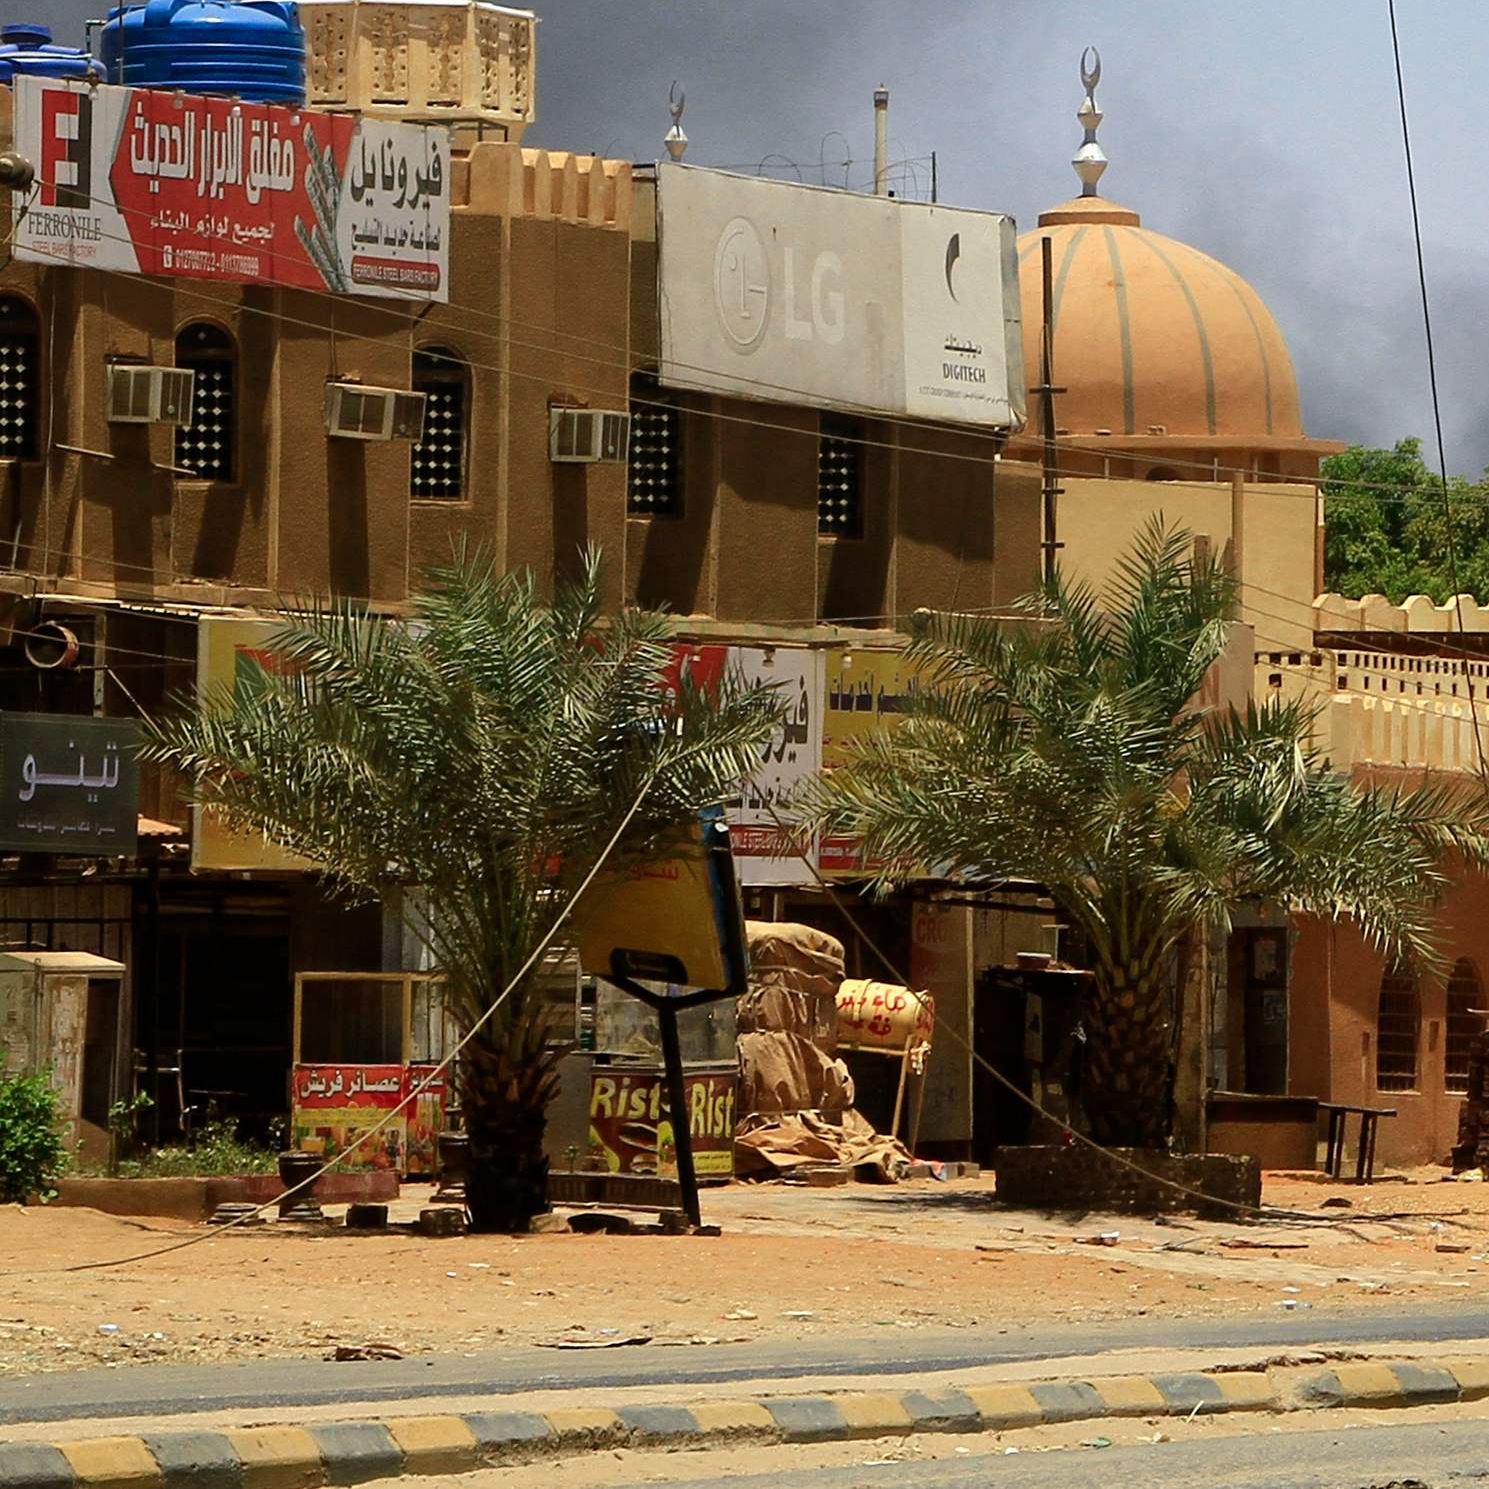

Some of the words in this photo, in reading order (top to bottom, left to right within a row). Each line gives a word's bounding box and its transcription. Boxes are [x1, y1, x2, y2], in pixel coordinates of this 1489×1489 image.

[131, 101, 195, 193] الحديث
[351, 137, 442, 209] فيرونايل
[28, 212, 102, 241] FERRONILE
[783, 245, 846, 345] LG
[942, 363, 986, 383] DIGITECH
[18, 739, 119, 801] تينو
[301, 1070, 343, 1098] فريش
[590, 1077, 661, 1120] Rist
[690, 1079, 734, 1138] Rist
